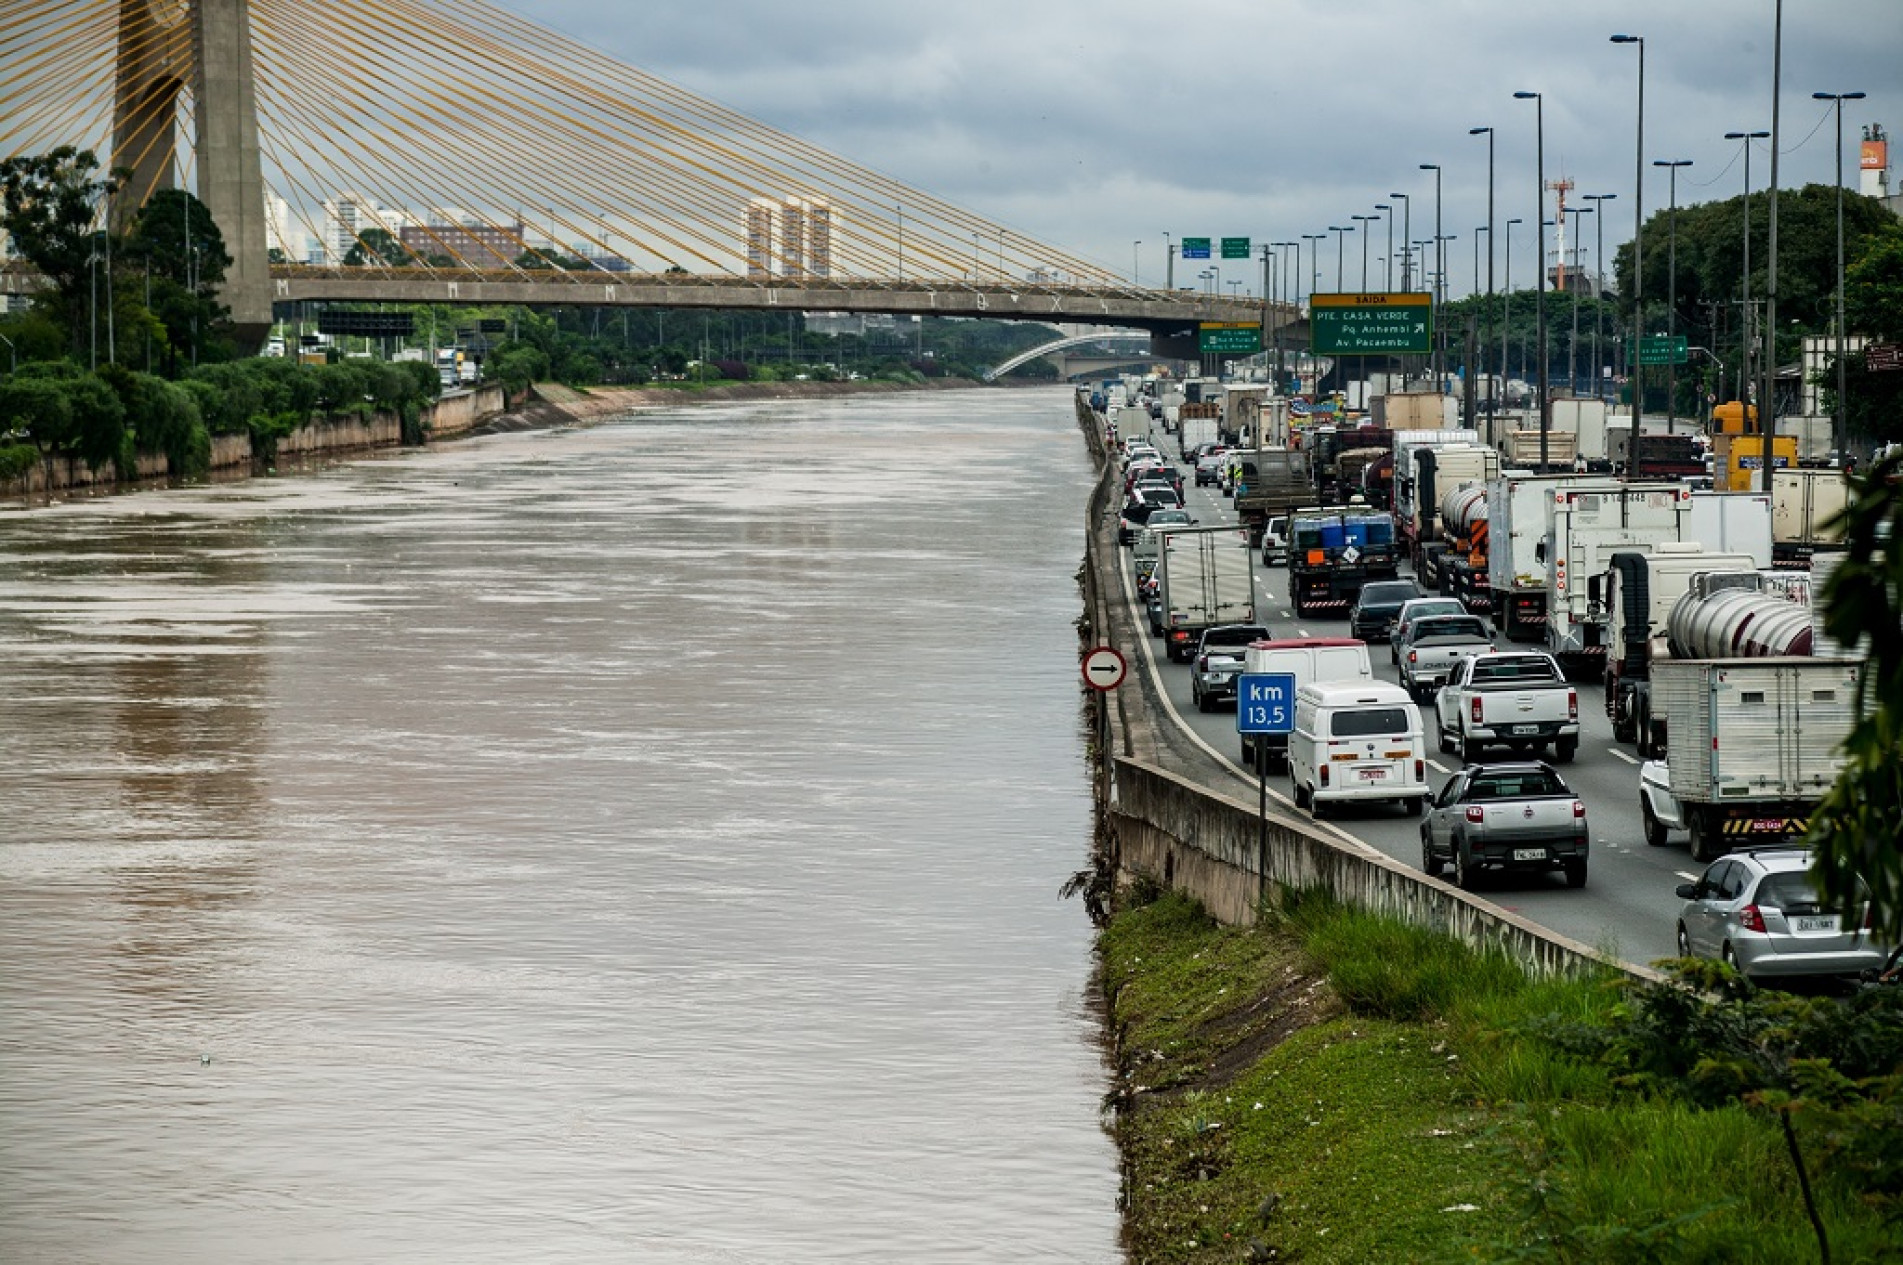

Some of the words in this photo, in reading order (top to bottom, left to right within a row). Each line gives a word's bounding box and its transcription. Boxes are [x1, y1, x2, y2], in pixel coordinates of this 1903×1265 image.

[1343, 311, 1372, 320] CASA
[1376, 311, 1410, 320] VERDE
[1361, 324, 1410, 334] Anhembi
[1336, 338, 1351, 347] Av.
[1356, 338, 1410, 347] Pacaembu
[1250, 683, 1283, 701] km
[1249, 706, 1285, 725] 13,5
